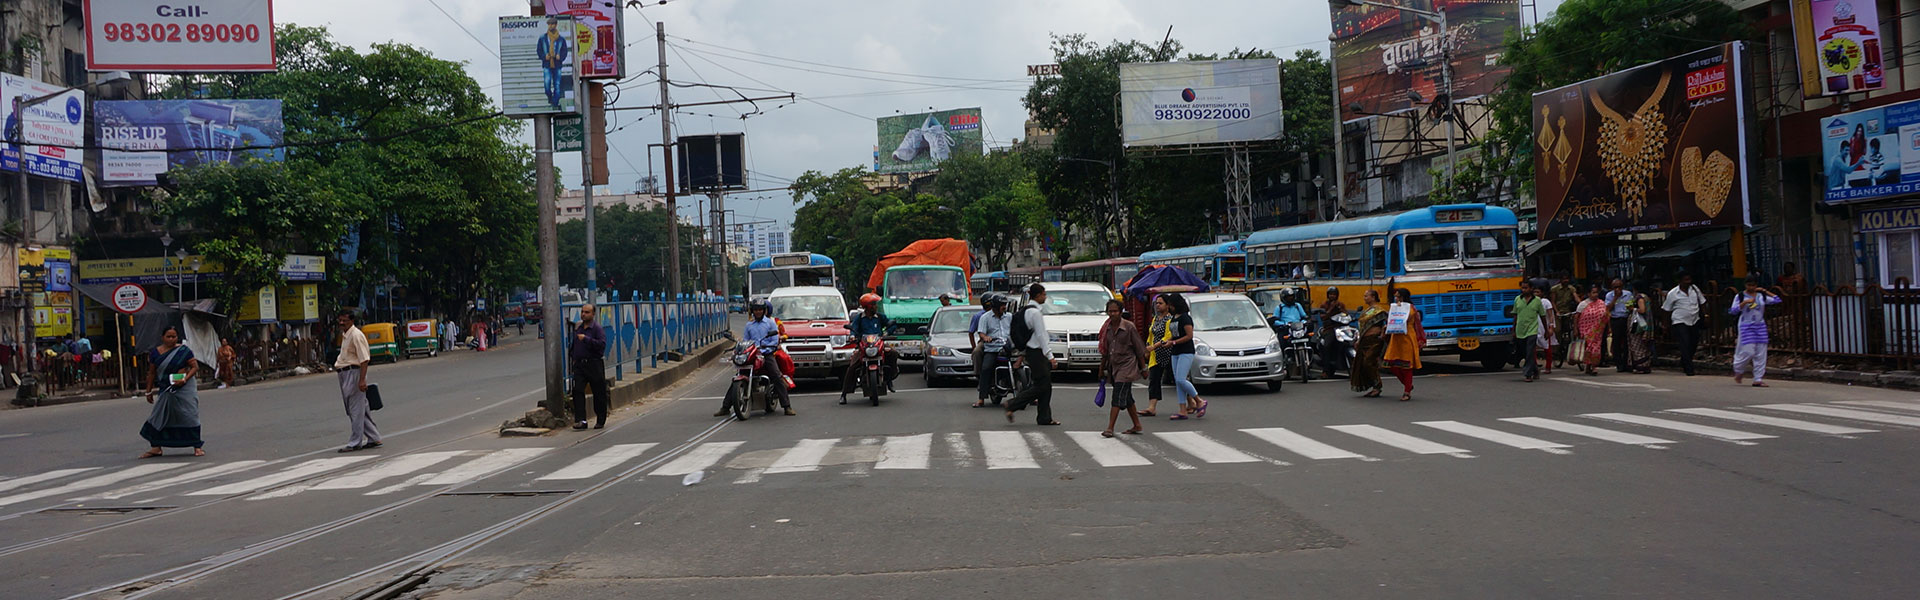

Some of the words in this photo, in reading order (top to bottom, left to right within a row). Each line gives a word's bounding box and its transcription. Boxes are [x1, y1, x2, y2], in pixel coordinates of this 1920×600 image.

[156, 5, 208, 18] Call-
[501, 20, 539, 29] PASSPORT
[104, 22, 181, 42] 98302
[186, 23, 260, 42] 89090
[1027, 64, 1060, 76] MER
[1689, 81, 1725, 97] GOLD
[949, 114, 979, 126] Elite
[1154, 108, 1251, 120] 9830922000
[101, 126, 139, 140] RISE
[142, 126, 167, 140] UP
[109, 142, 160, 150] ETERNIA
[1827, 190, 1847, 199] THE
[1850, 186, 1893, 197] BANKER
[1895, 184, 1911, 192] TO
[1448, 210, 1459, 221] 21
[1861, 208, 1920, 230] KOLKAT
